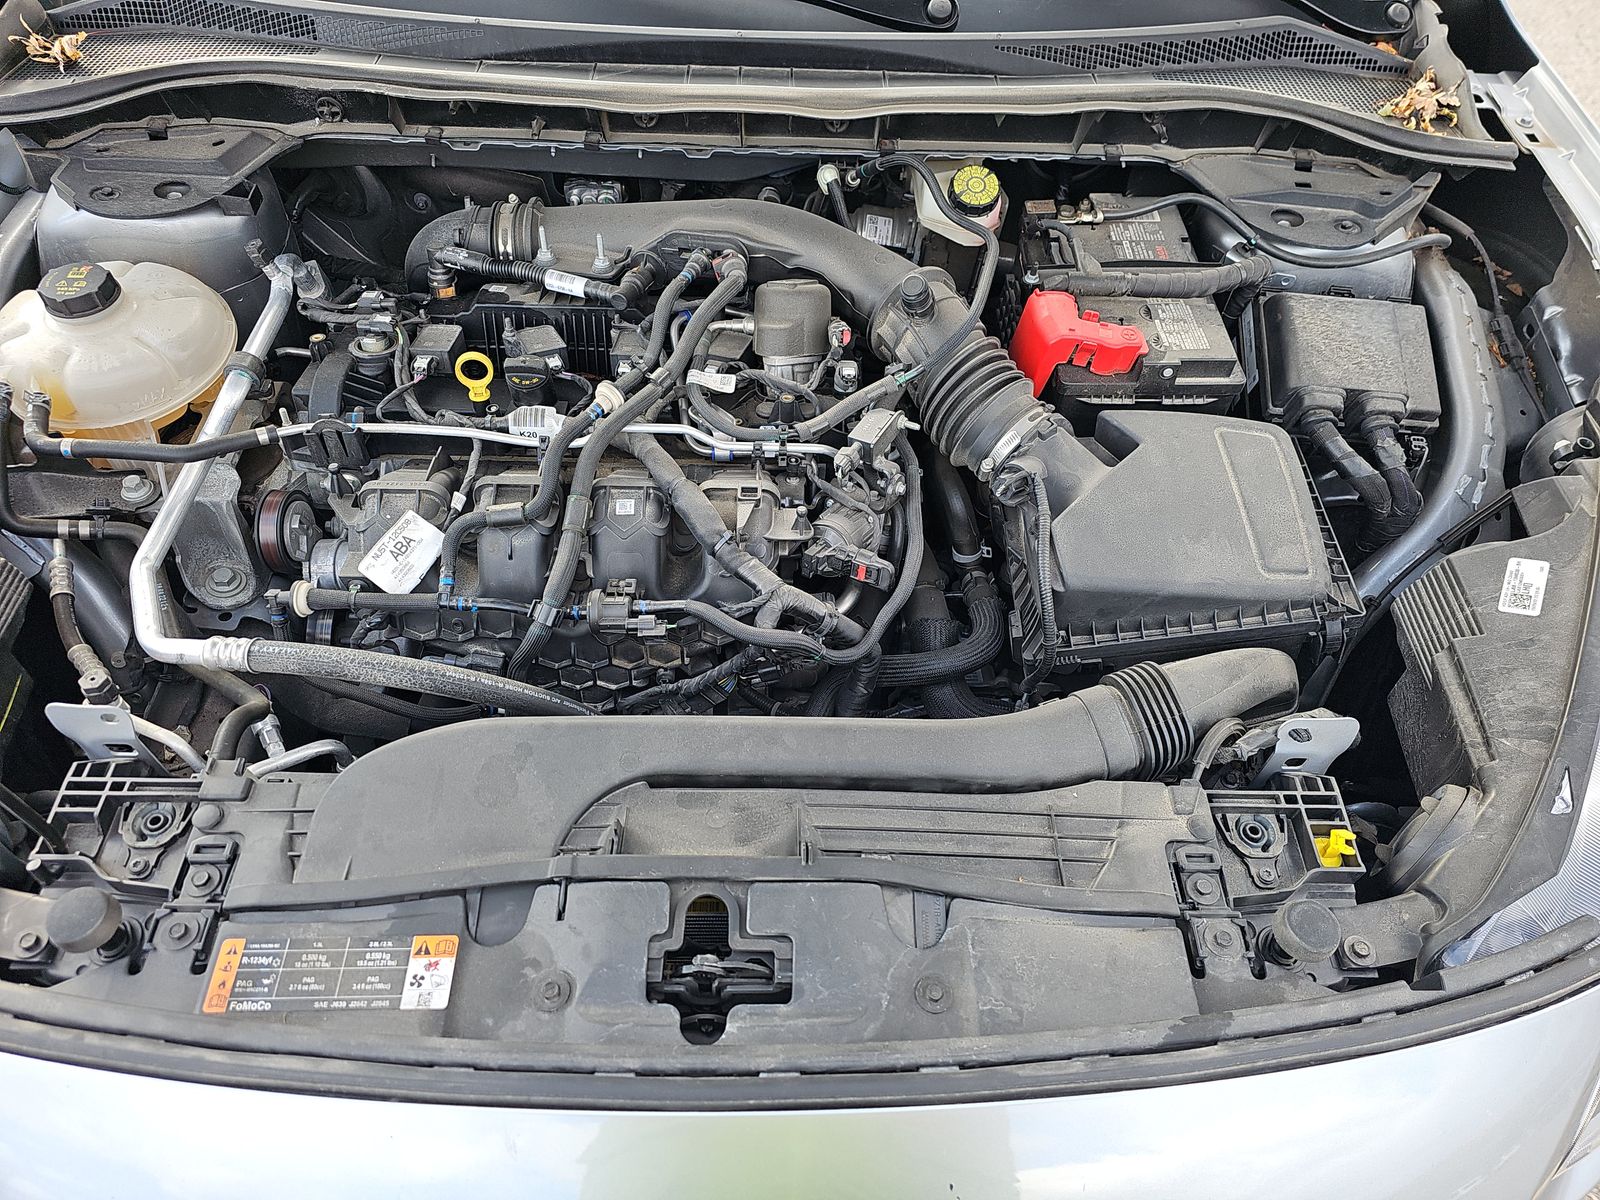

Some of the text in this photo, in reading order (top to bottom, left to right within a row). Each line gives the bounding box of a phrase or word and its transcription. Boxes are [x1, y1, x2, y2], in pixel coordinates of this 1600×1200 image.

[389, 536, 416, 562] ABA
[524, 688, 550, 701] SUCTION
[230, 1000, 271, 1010] FoMoCo
